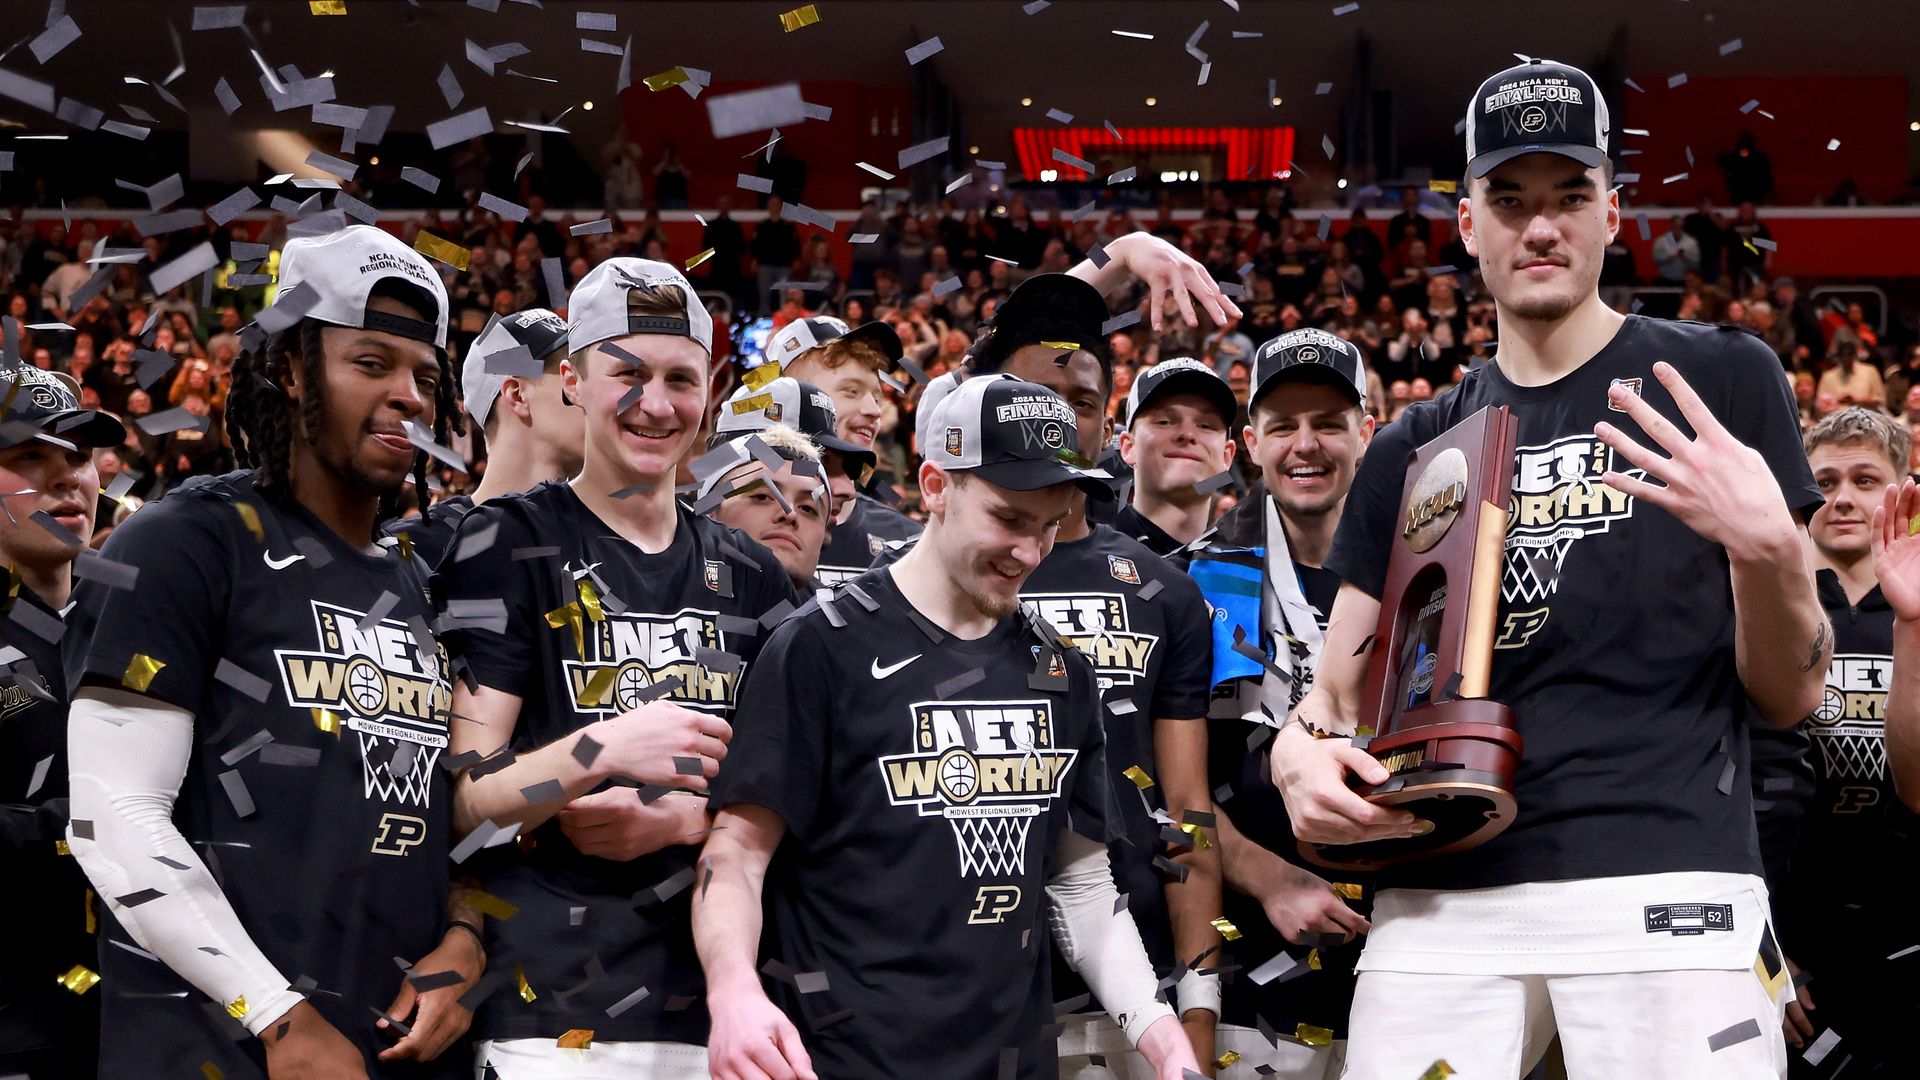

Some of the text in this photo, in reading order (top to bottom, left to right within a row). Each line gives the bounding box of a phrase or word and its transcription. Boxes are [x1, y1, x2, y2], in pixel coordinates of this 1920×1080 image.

[1499, 78, 1569, 92] 2024 NCAA MEN'S
[1485, 85, 1583, 114] FINAL FOUR
[1524, 113, 1543, 126] P
[360, 260, 403, 274] REGIONAL
[369, 252, 426, 274] NCAA MEN'S
[1266, 334, 1348, 359] FINAL FOUR
[1035, 395, 1057, 404] NCAA
[998, 403, 1053, 422] FINAL
[1403, 481, 1464, 539] NCAA
[1512, 483, 1630, 528] RTHY
[1515, 537, 1551, 546] REGIONAL
[1417, 596, 1446, 621] DIVISIO
[1494, 607, 1550, 650] P
[612, 617, 703, 668] NET
[287, 657, 452, 721] WORTH
[1812, 687, 1889, 725] ORT
[358, 721, 441, 745] MIDWEST REGIONAL CHAMPS
[932, 709, 1035, 754] NET
[1379, 750, 1424, 773] HAMPION
[887, 750, 1067, 803] WORTHY
[950, 807, 1033, 816] MIDWEST REGIONAL CHAMPS
[1832, 786, 1880, 814] P
[371, 812, 427, 856] P
[967, 885, 1022, 925] P
[1707, 911, 1722, 923] 52
